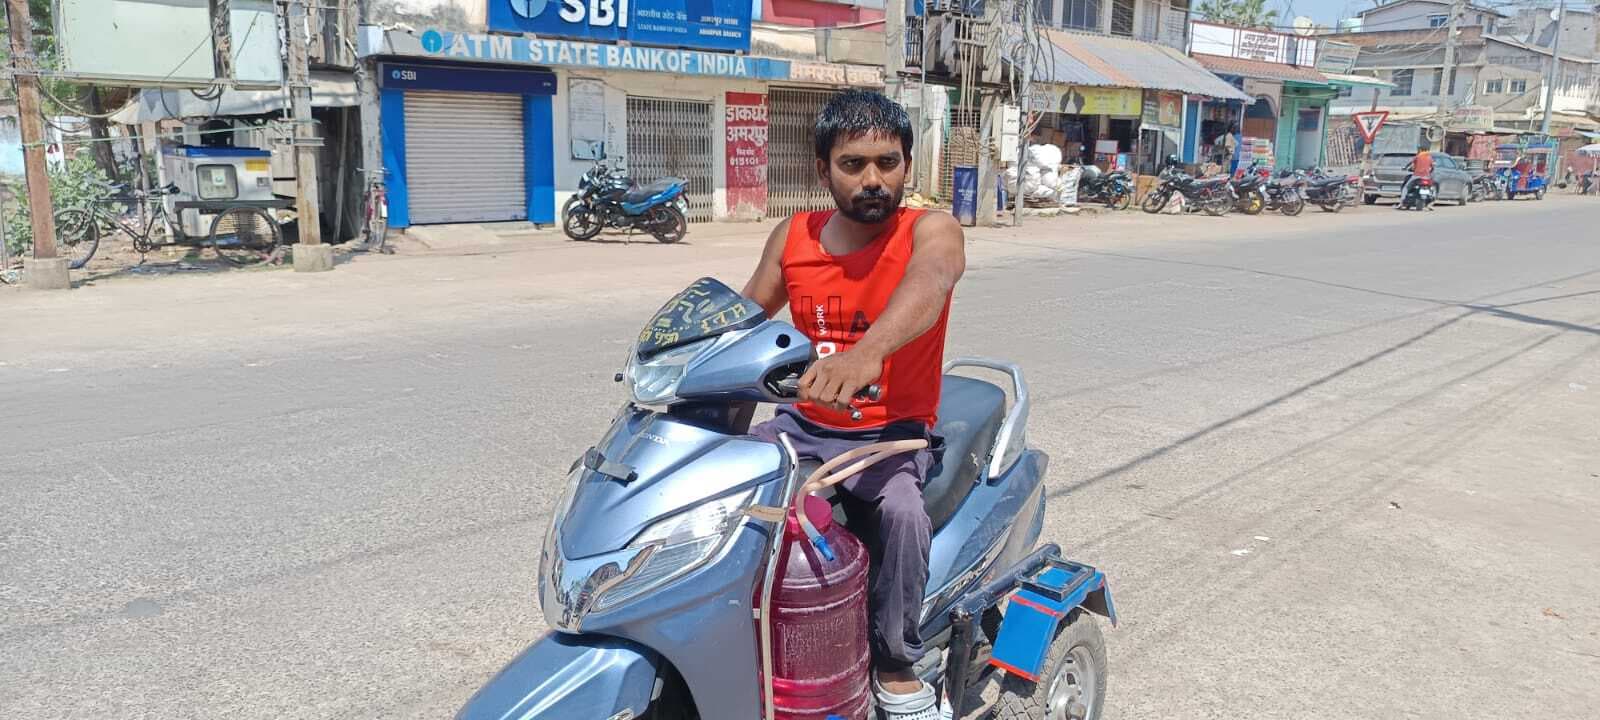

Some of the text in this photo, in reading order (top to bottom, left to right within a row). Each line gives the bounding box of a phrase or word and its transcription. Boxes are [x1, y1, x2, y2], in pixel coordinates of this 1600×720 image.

[559, 0, 628, 28] SBI
[450, 32, 513, 60] ATM
[528, 39, 599, 65] STATE
[697, 53, 747, 76] INDIA
[401, 70, 416, 80] SBI
[815, 304, 828, 336] WORK
